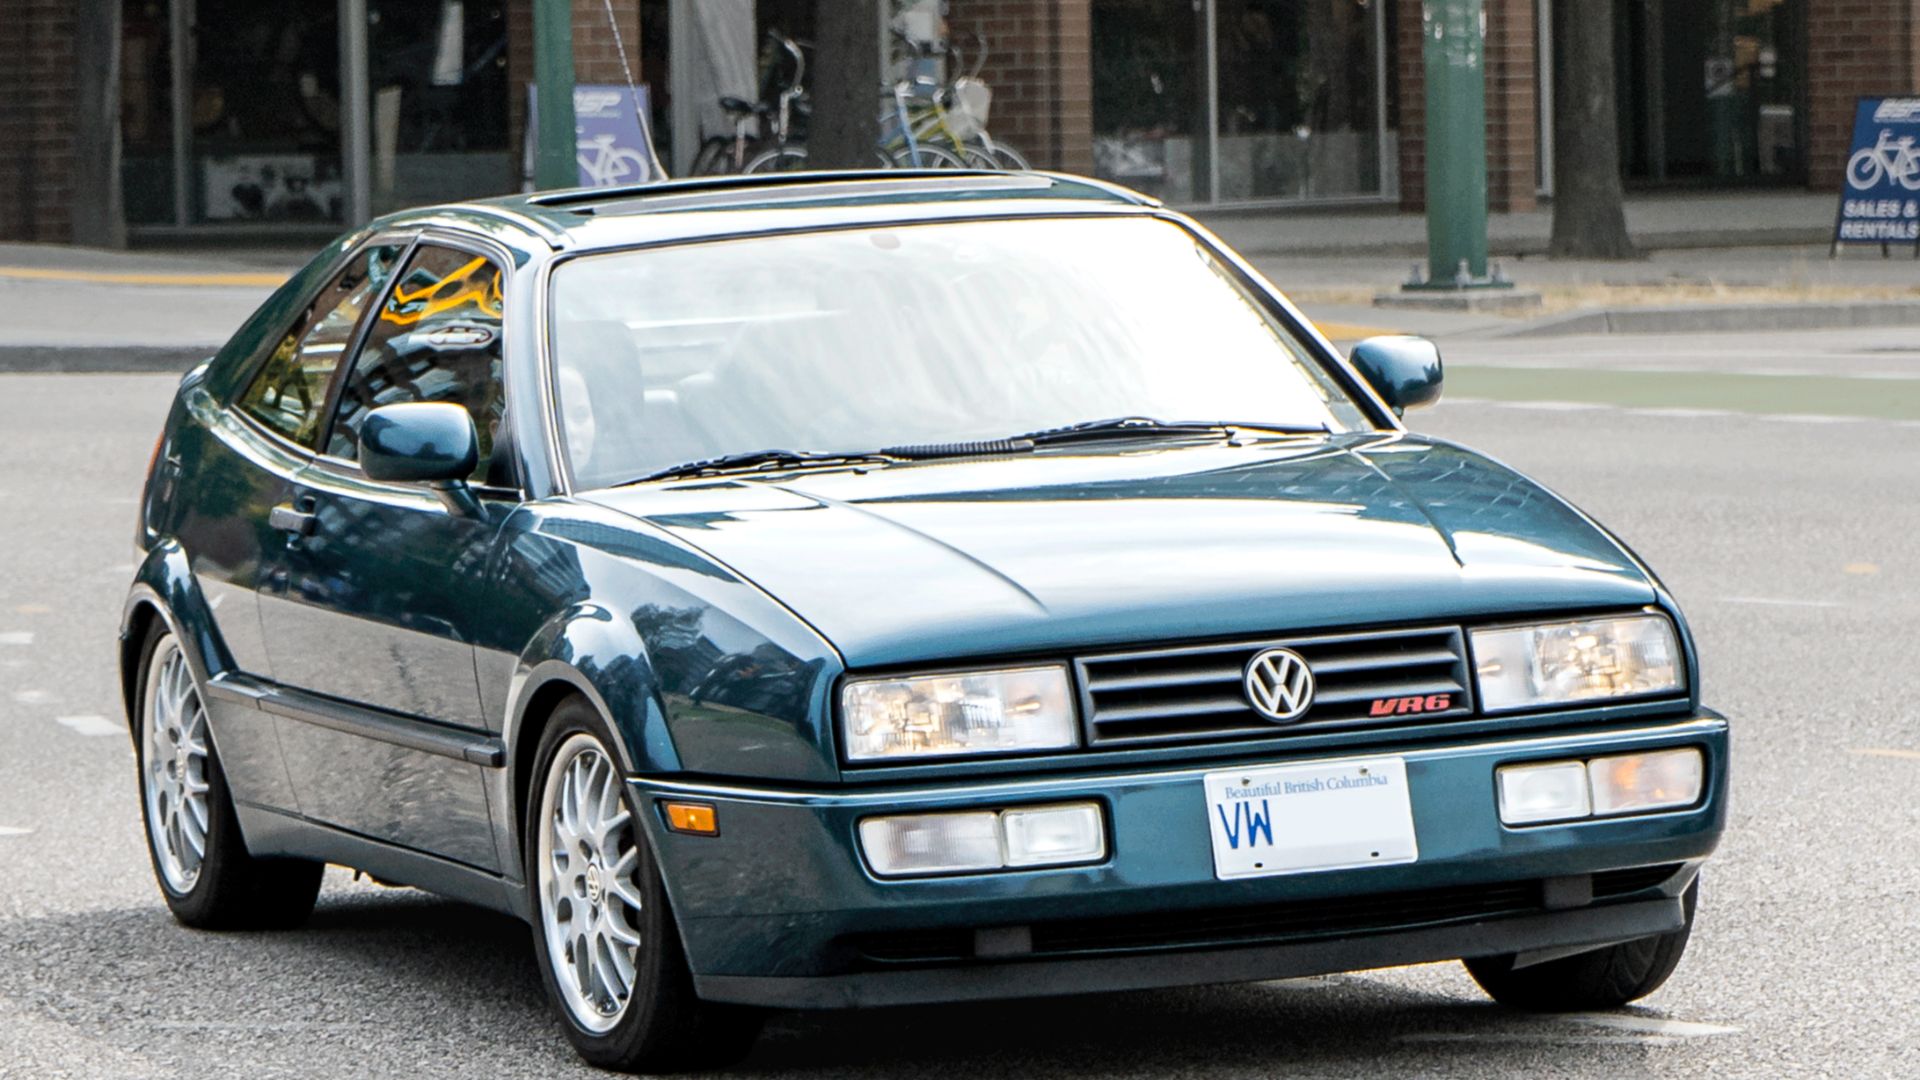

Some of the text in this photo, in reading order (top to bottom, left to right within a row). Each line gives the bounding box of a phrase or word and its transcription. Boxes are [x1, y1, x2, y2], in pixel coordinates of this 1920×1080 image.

[1843, 199, 1919, 218] SALES &
[1840, 220, 1920, 239] RENTALS
[1245, 648, 1314, 720] VW
[1369, 693, 1451, 717] VR6
[1225, 773, 1388, 799] Beautiful British Columbia
[1217, 799, 1274, 849] VW
